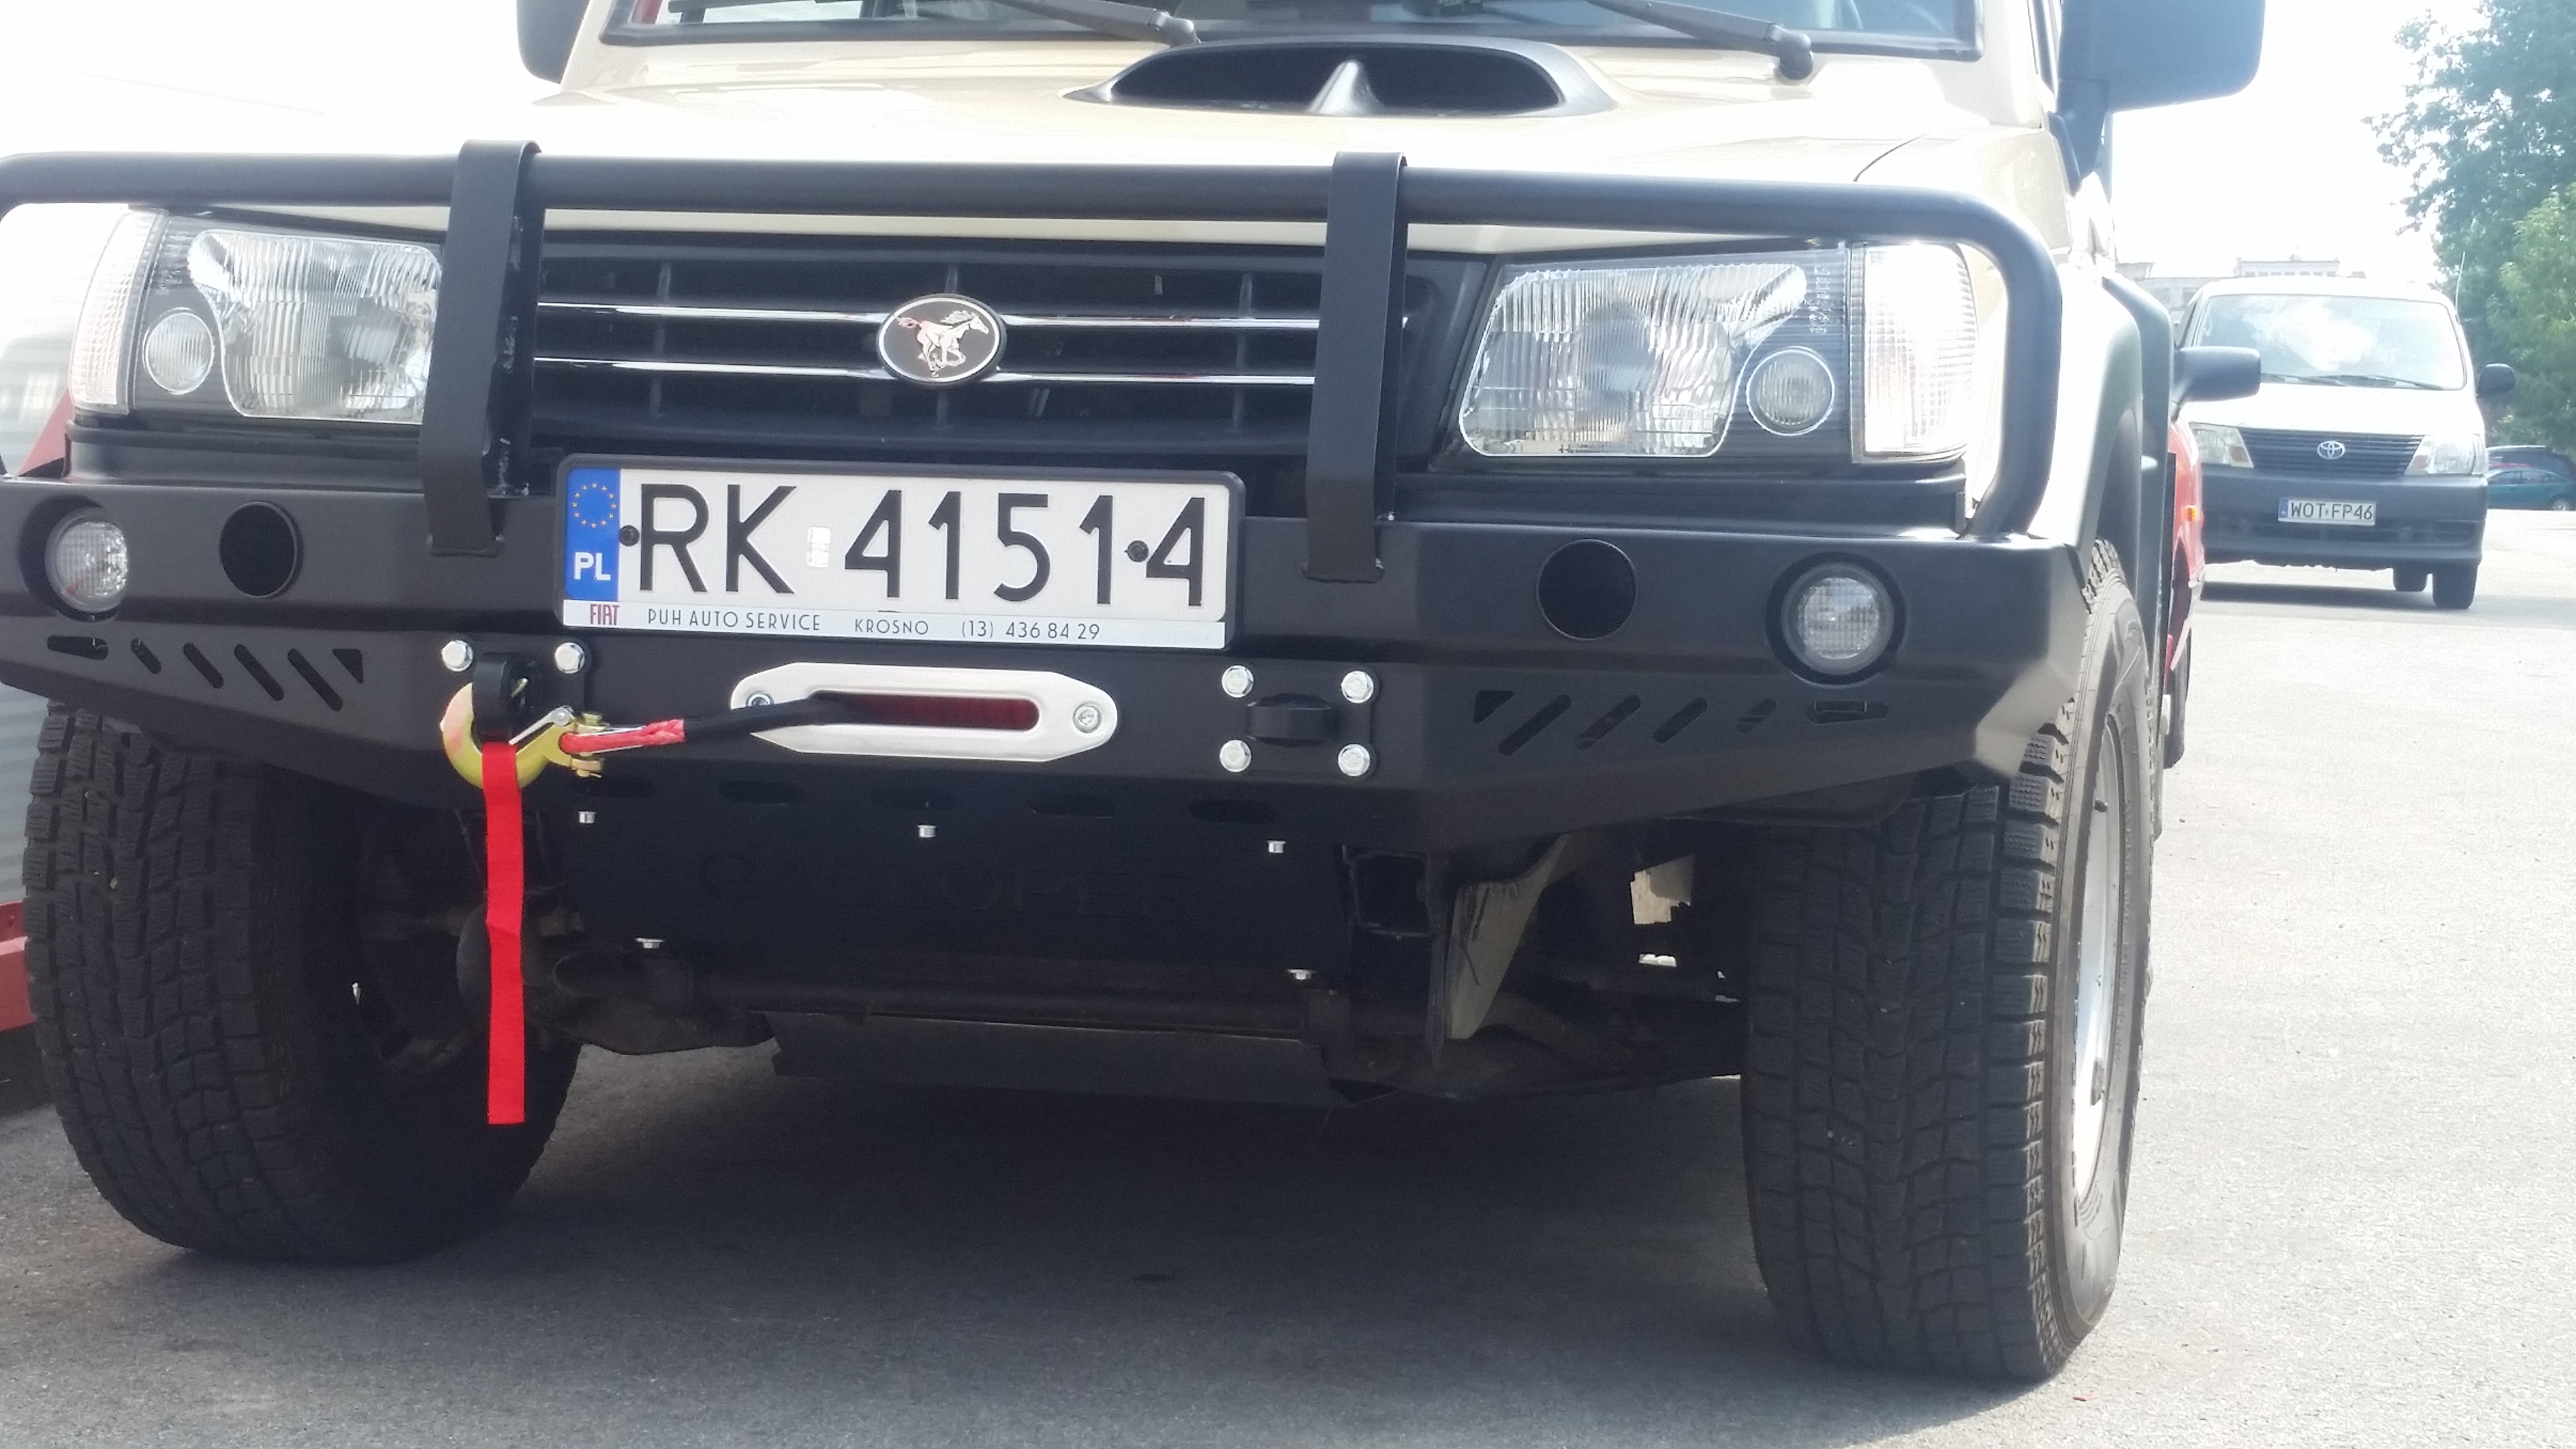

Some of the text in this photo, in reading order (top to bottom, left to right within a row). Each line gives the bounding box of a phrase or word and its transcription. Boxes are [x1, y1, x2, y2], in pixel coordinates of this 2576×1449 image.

[2291, 502, 2373, 520] WOT FP46
[640, 483, 1205, 606] RK 41514
[574, 551, 612, 580] PL
[590, 604, 619, 626] FIAT
[648, 609, 1100, 640] PUH AUTO SERVICE KROSNO (13) 436 84 29
